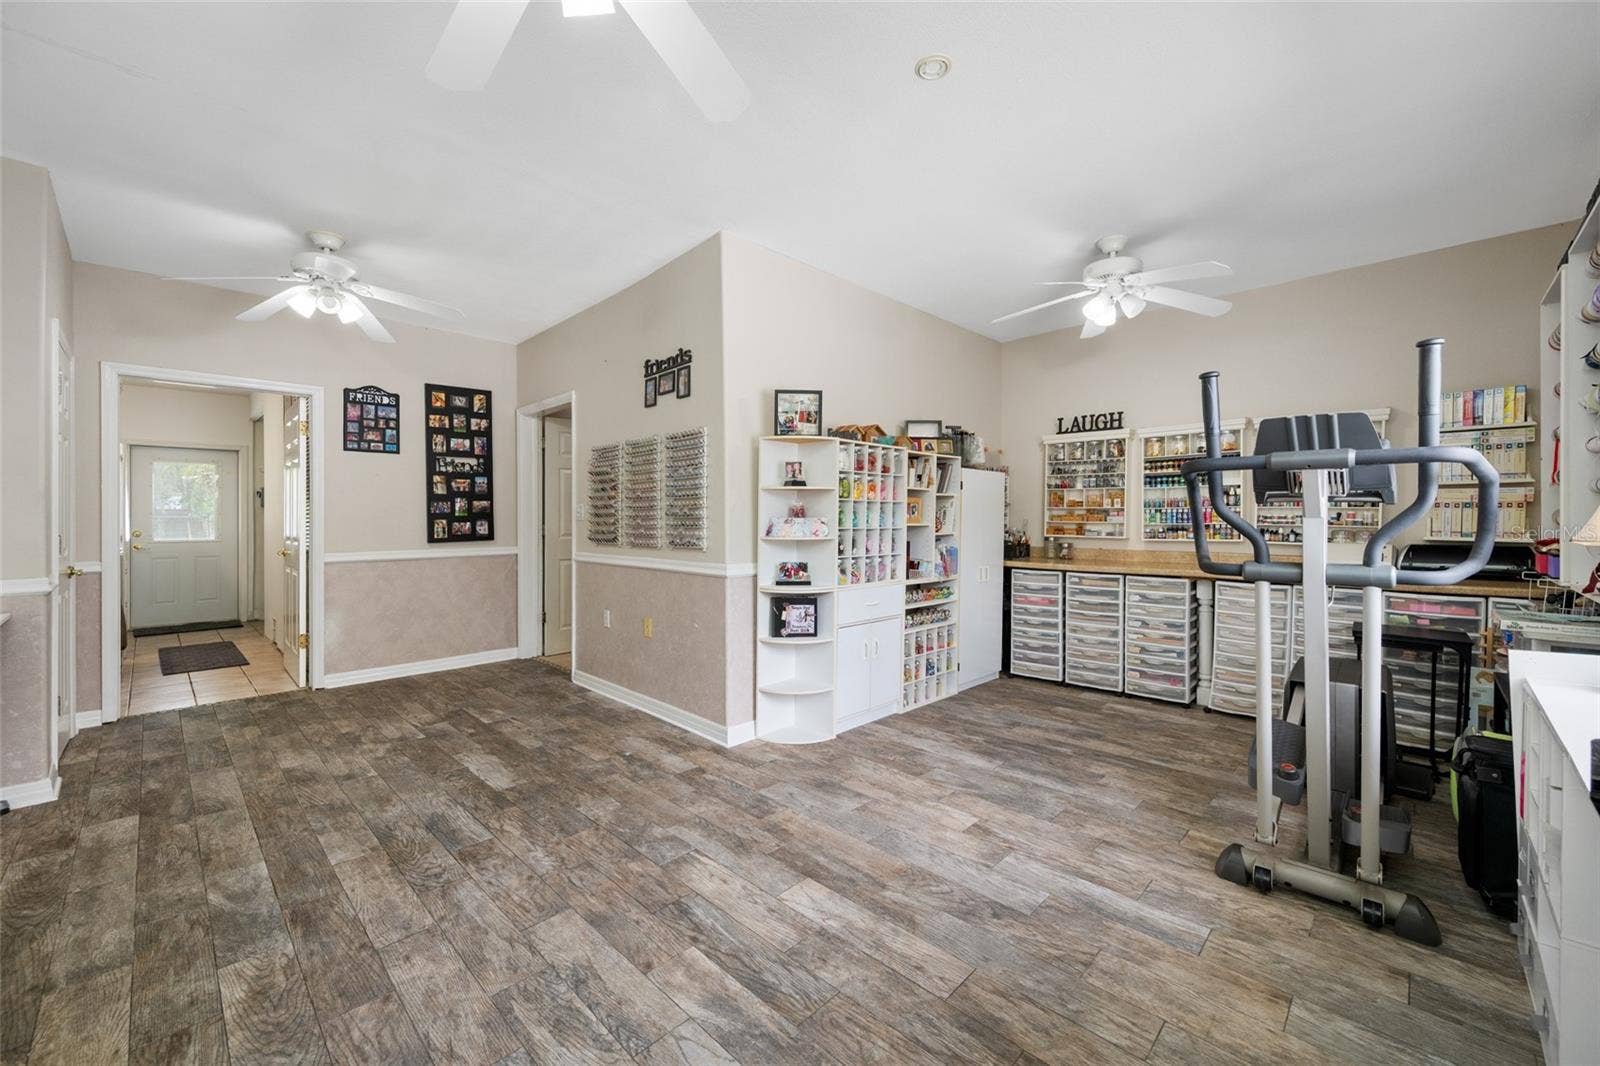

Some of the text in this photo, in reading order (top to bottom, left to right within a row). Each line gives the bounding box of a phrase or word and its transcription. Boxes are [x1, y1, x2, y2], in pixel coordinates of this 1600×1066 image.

[643, 347, 692, 378] friends
[349, 391, 396, 405] FRIENDS
[1055, 411, 1124, 435] LAUGH
[435, 455, 488, 474] Friends
